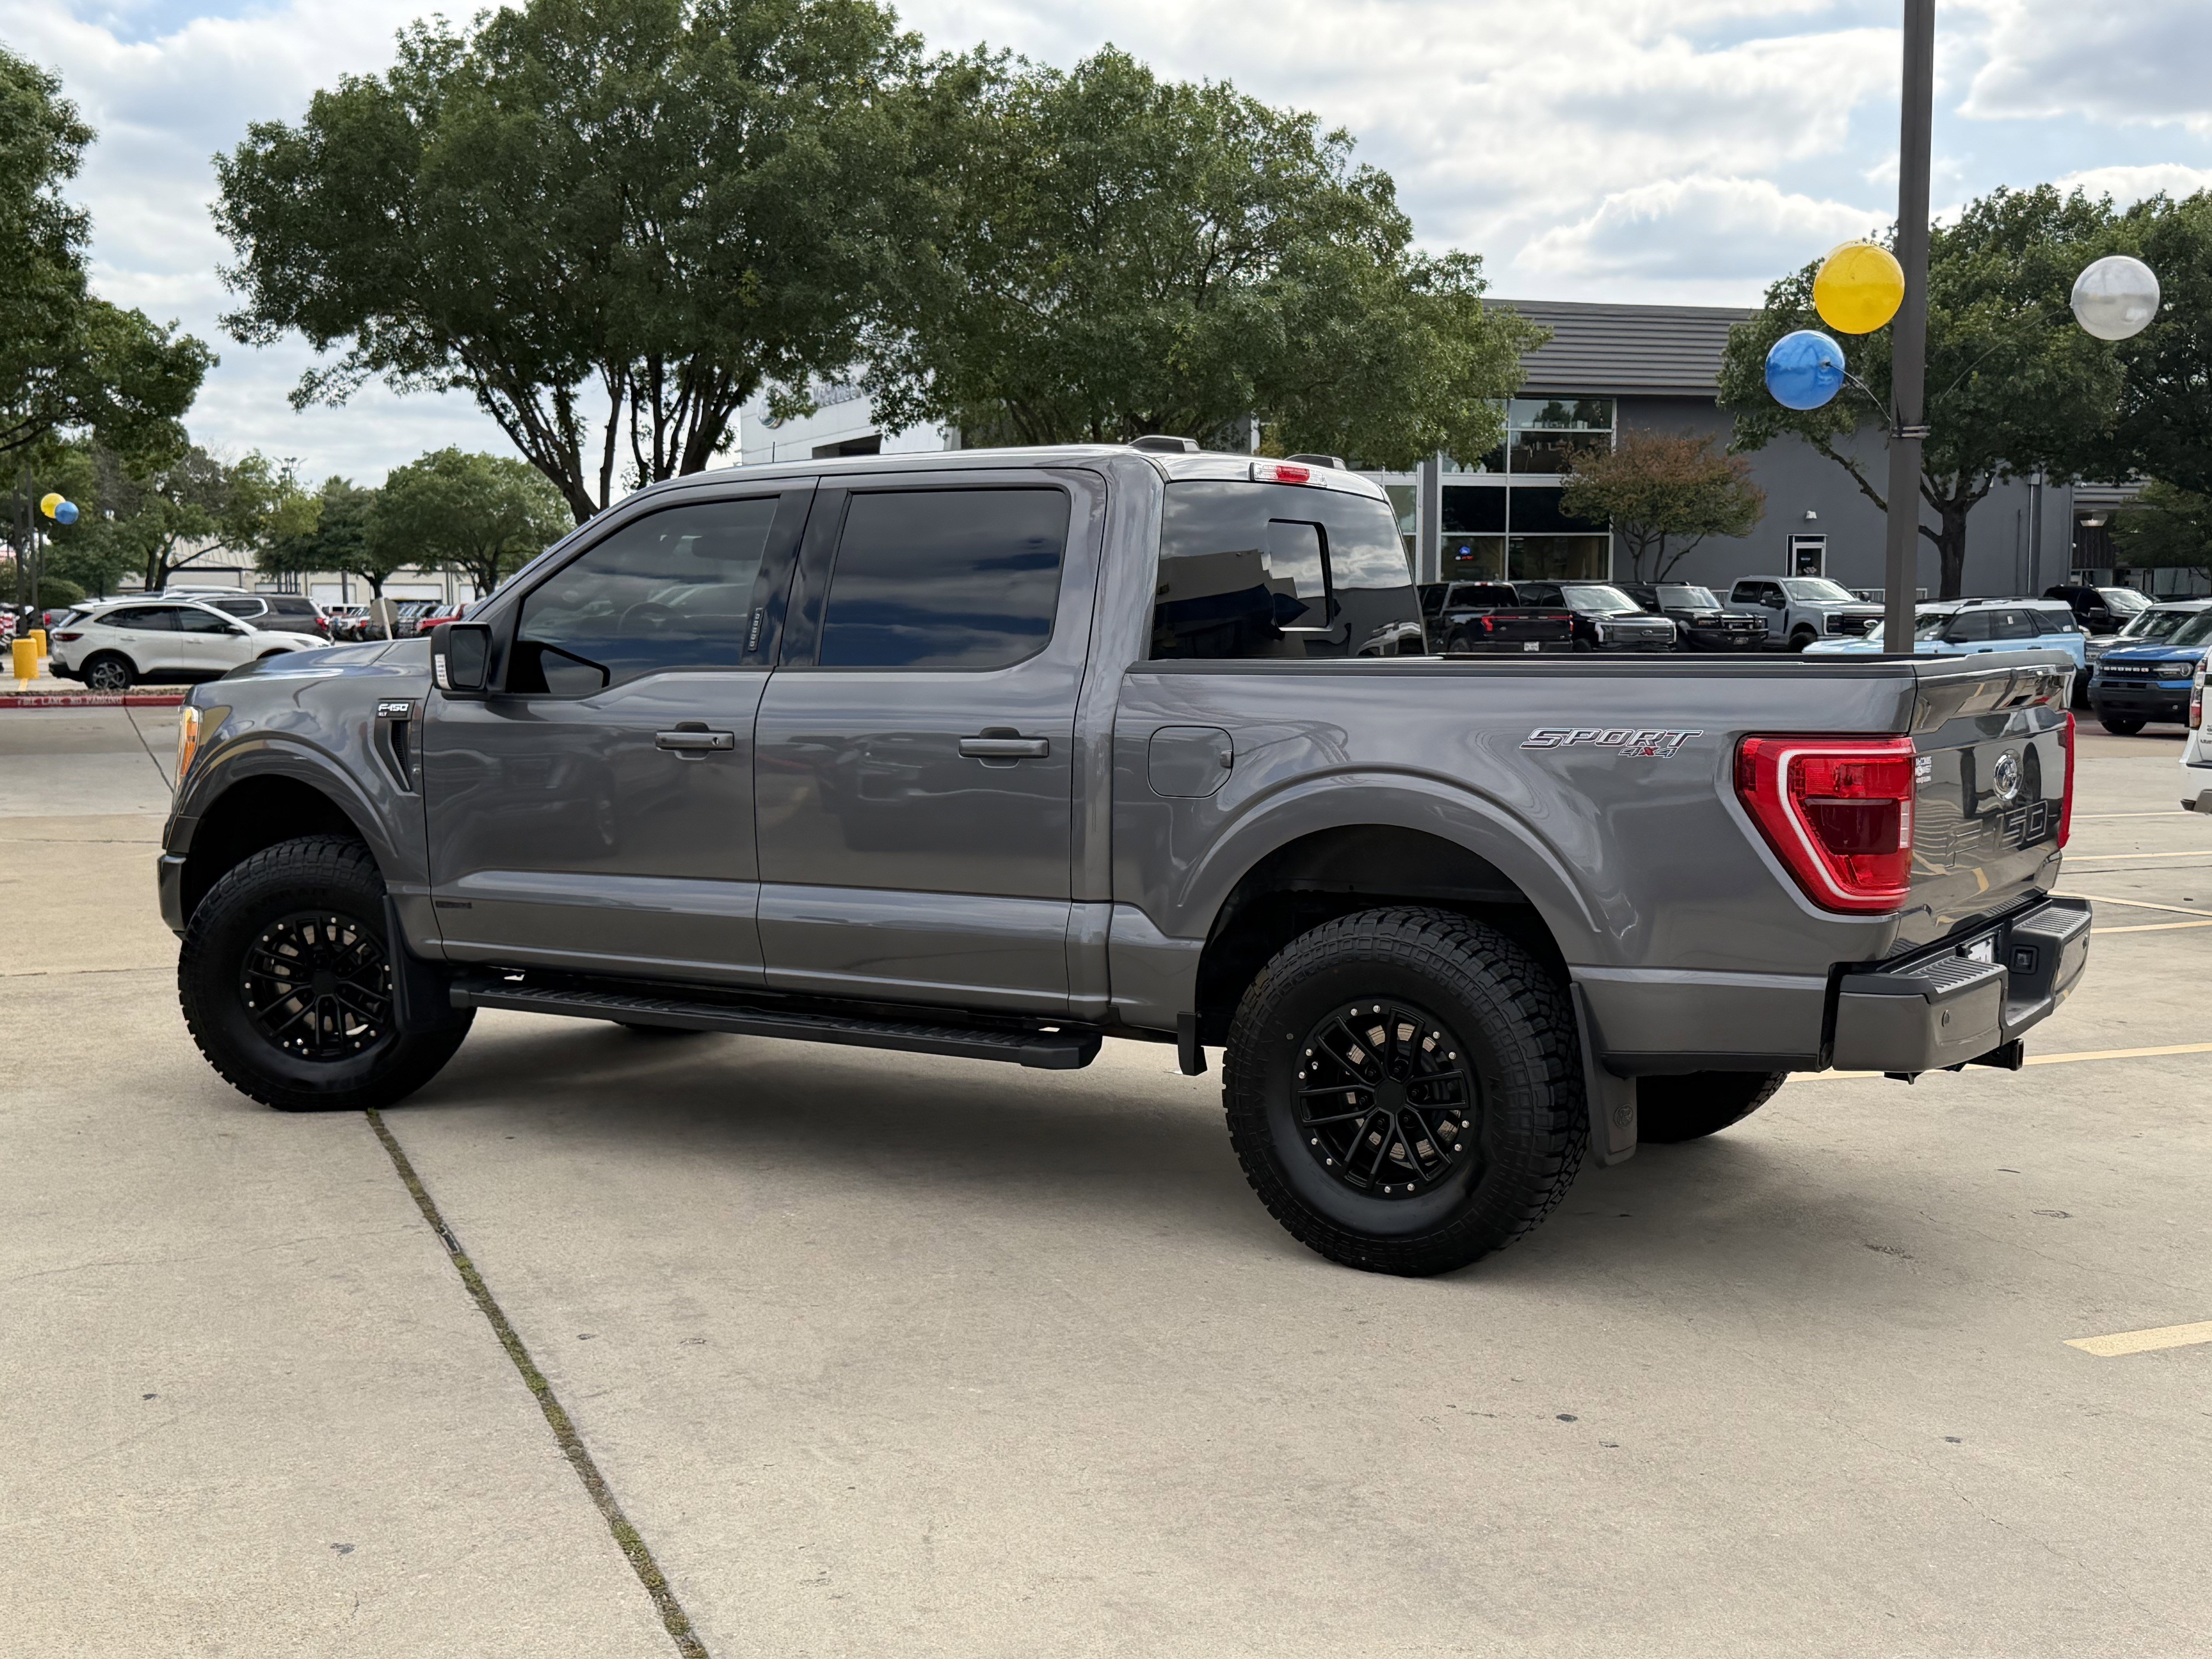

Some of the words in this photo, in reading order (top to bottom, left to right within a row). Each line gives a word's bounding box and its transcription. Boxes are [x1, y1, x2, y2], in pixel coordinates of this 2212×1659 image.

[41, 697, 62, 705] LANE
[378, 703, 409, 711] F-150
[1520, 728, 1704, 749] SPORT
